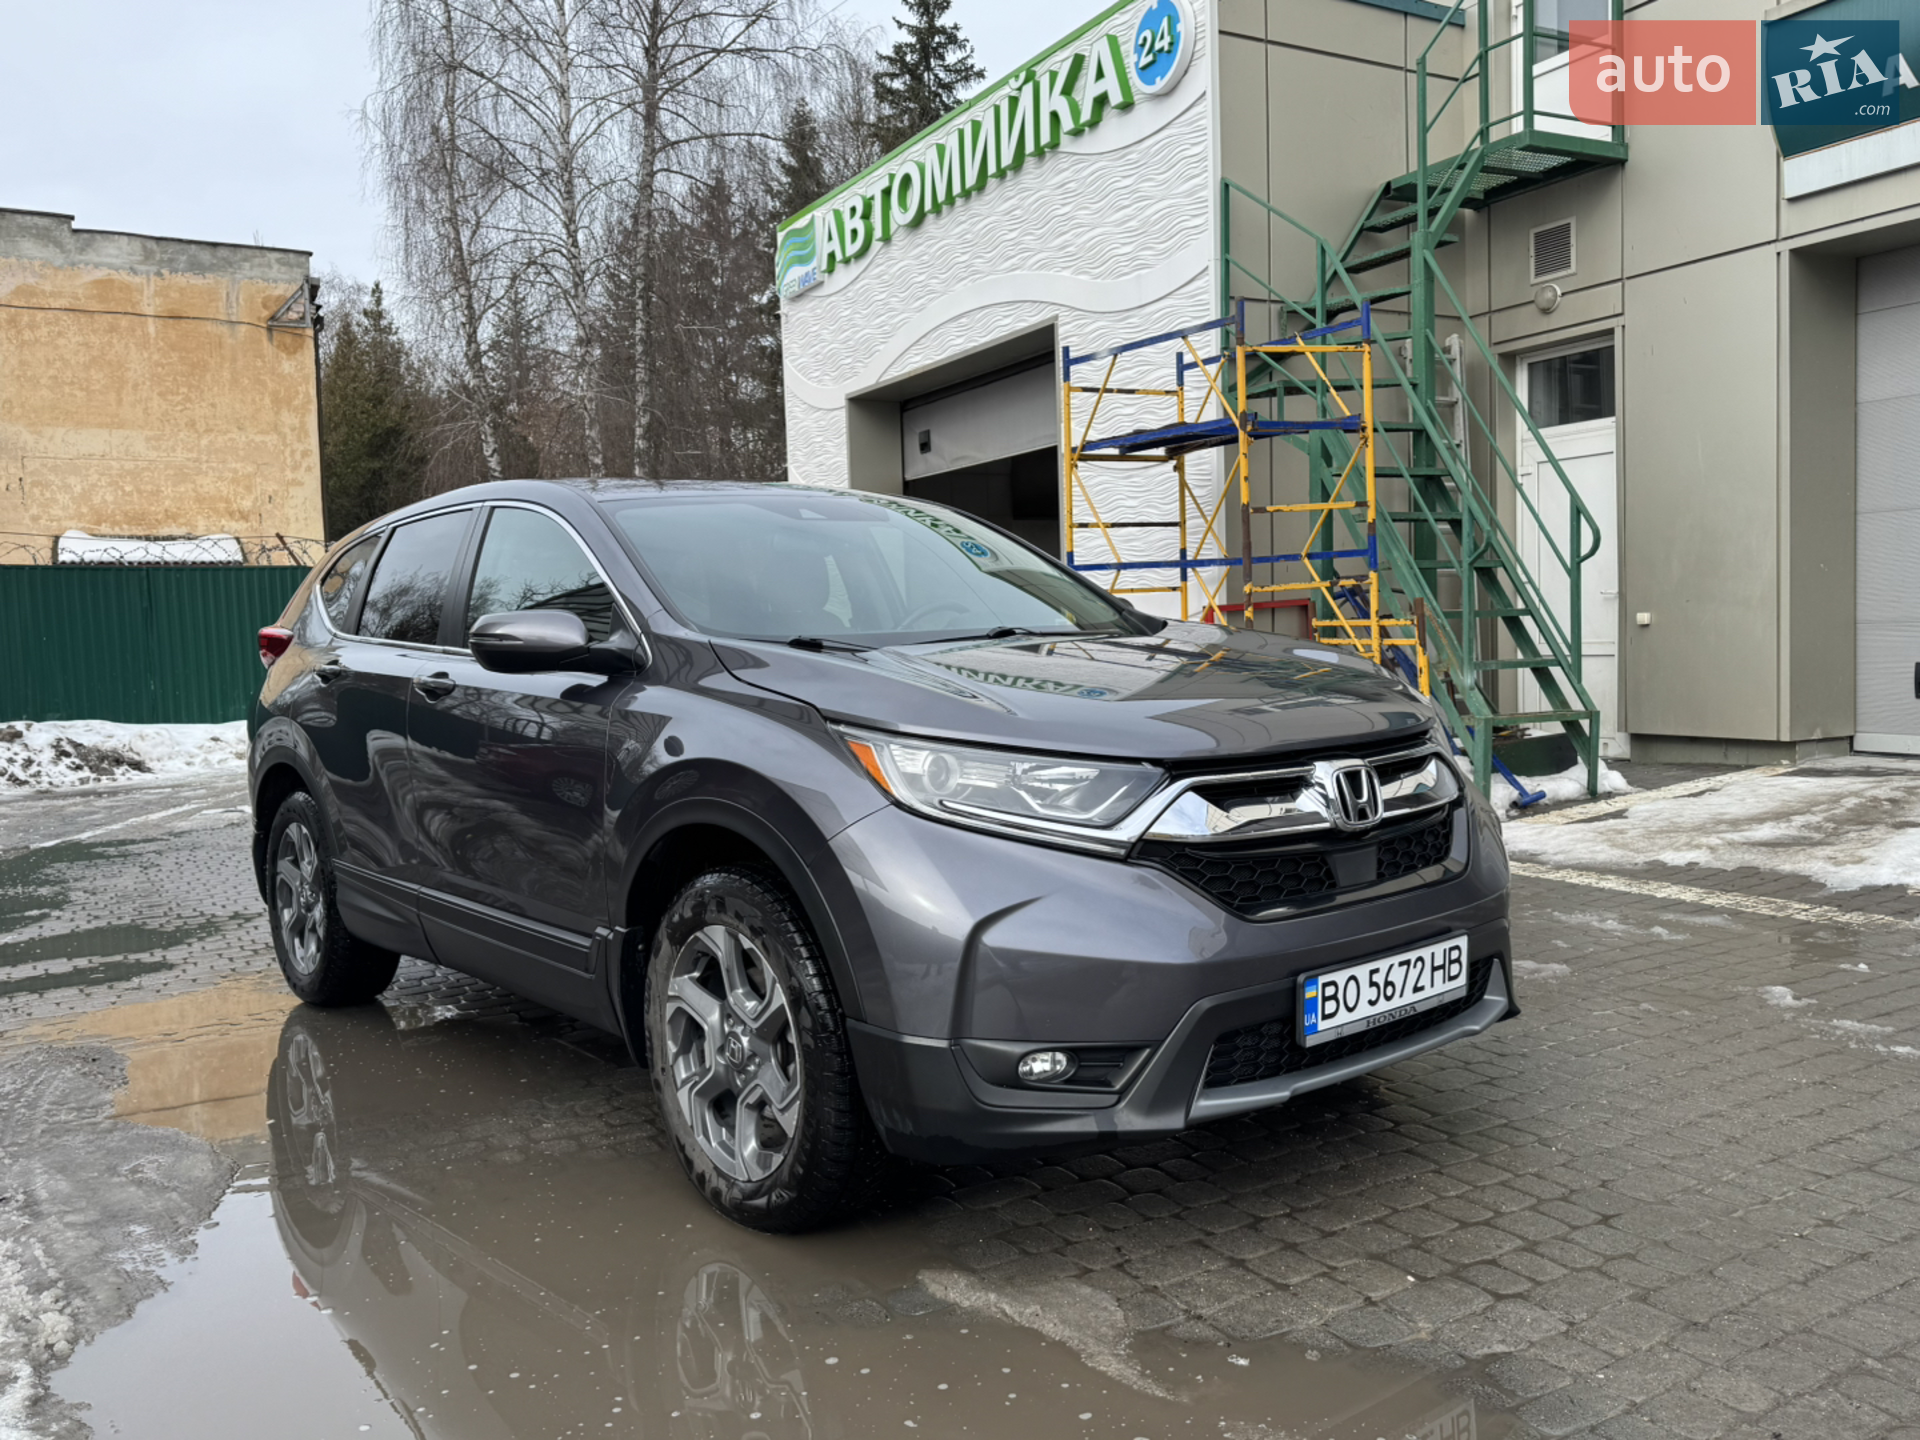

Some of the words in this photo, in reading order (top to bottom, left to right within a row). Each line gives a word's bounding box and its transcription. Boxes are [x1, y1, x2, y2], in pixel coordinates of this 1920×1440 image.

[1138, 14, 1173, 71] 24
[819, 33, 1134, 273] АВТОМИЙКА
[1321, 974, 1361, 1021] BO
[1367, 955, 1426, 1007] 5672
[1430, 944, 1463, 988] HB
[1304, 1013, 1317, 1026] UA
[1365, 1005, 1419, 1029] HONDA
